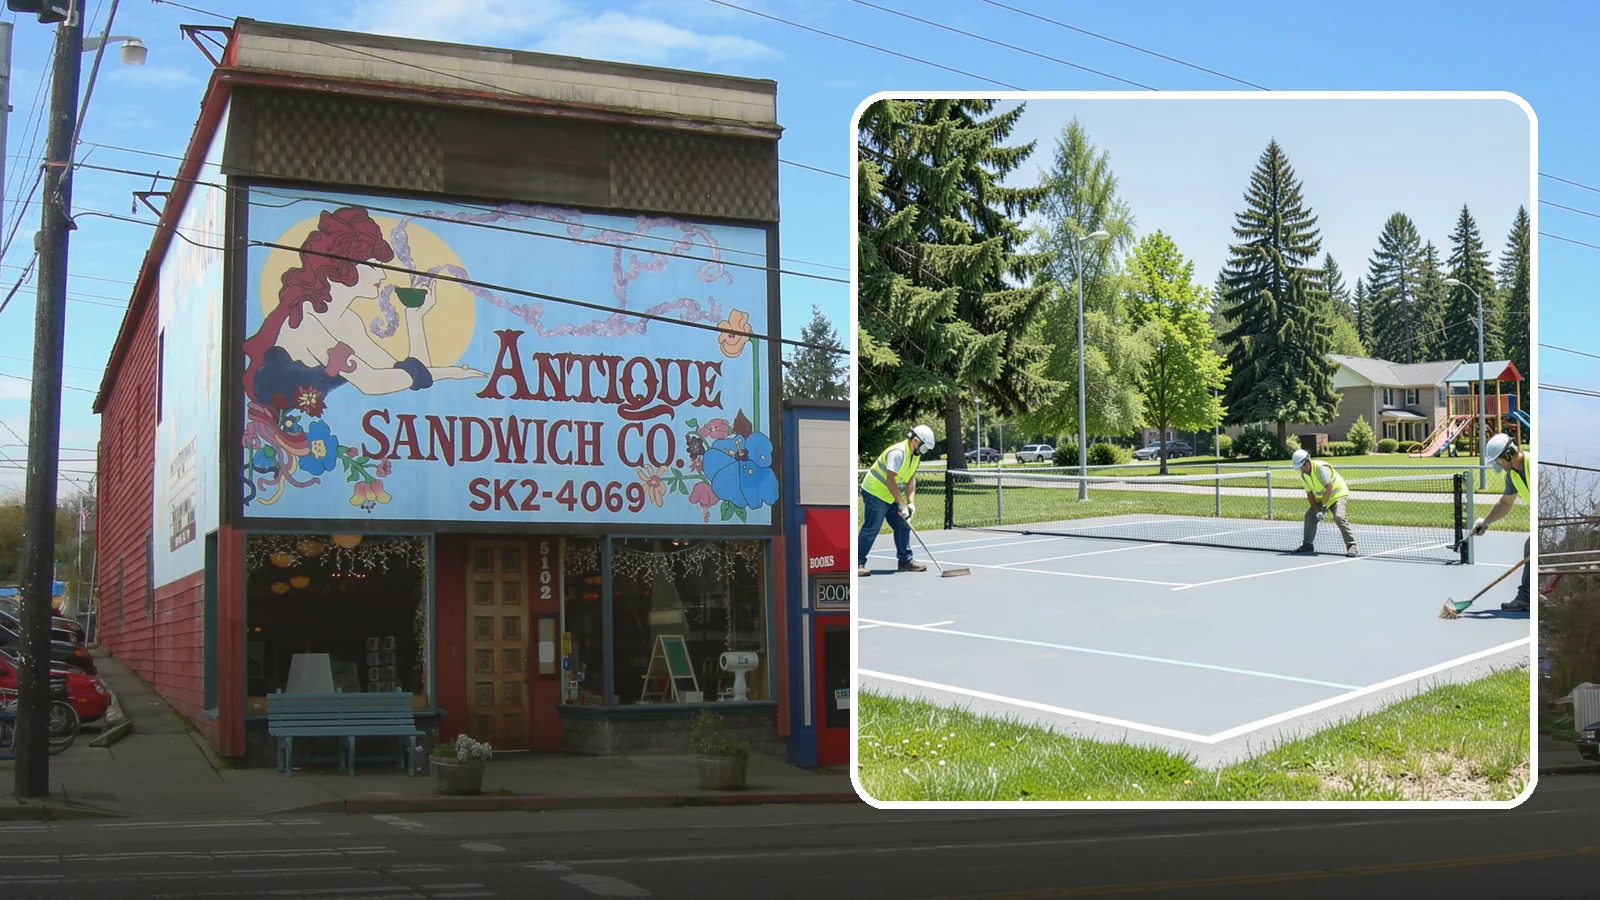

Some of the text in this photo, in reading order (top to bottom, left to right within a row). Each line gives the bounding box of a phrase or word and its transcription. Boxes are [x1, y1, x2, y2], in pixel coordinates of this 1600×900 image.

[476, 329, 723, 420] ANTIQUE
[361, 409, 684, 468] SANDWICH CO.
[468, 477, 645, 513] SK2-4069
[540, 541, 551, 599] 5102
[810, 555, 834, 568] BOOKS
